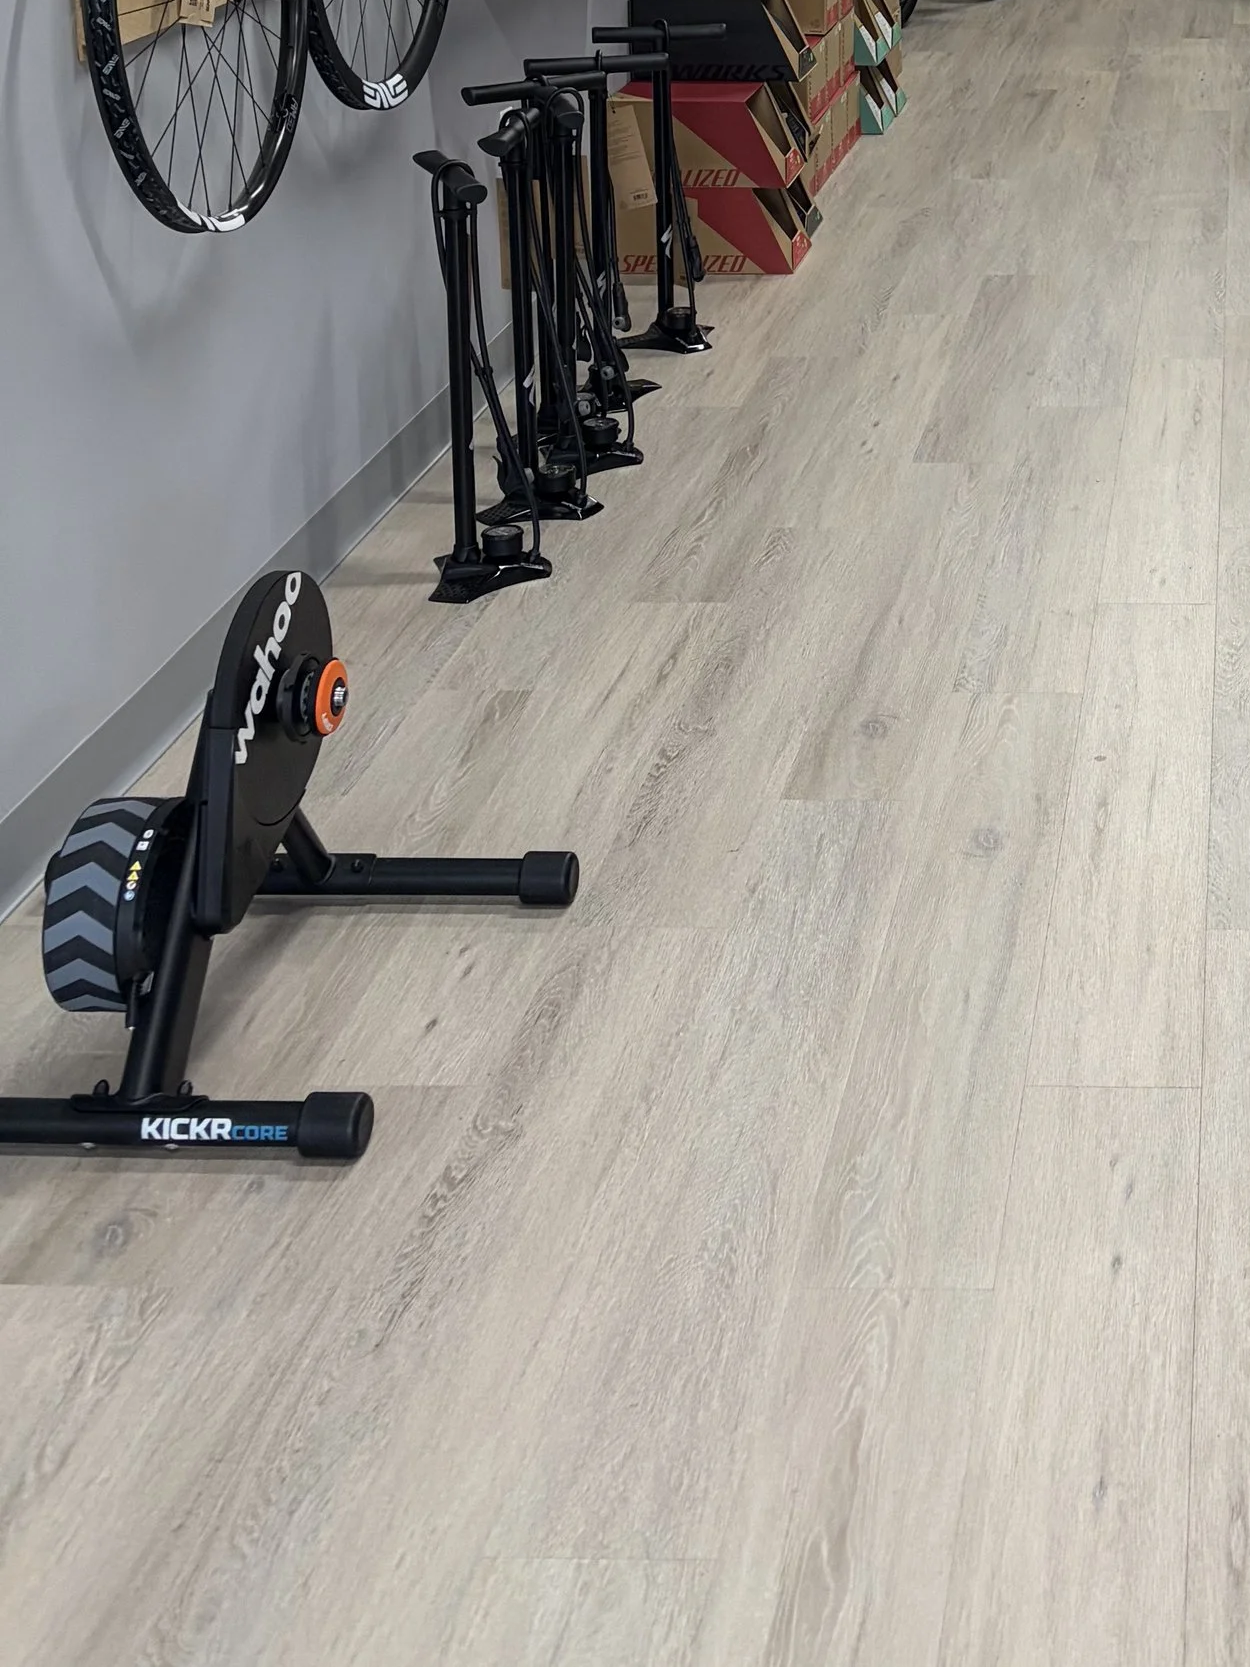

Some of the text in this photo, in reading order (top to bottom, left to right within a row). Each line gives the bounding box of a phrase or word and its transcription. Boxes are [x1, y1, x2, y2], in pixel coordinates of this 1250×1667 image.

[233, 570, 302, 765] wahoo
[140, 1115, 289, 1142] KICKR CORE
